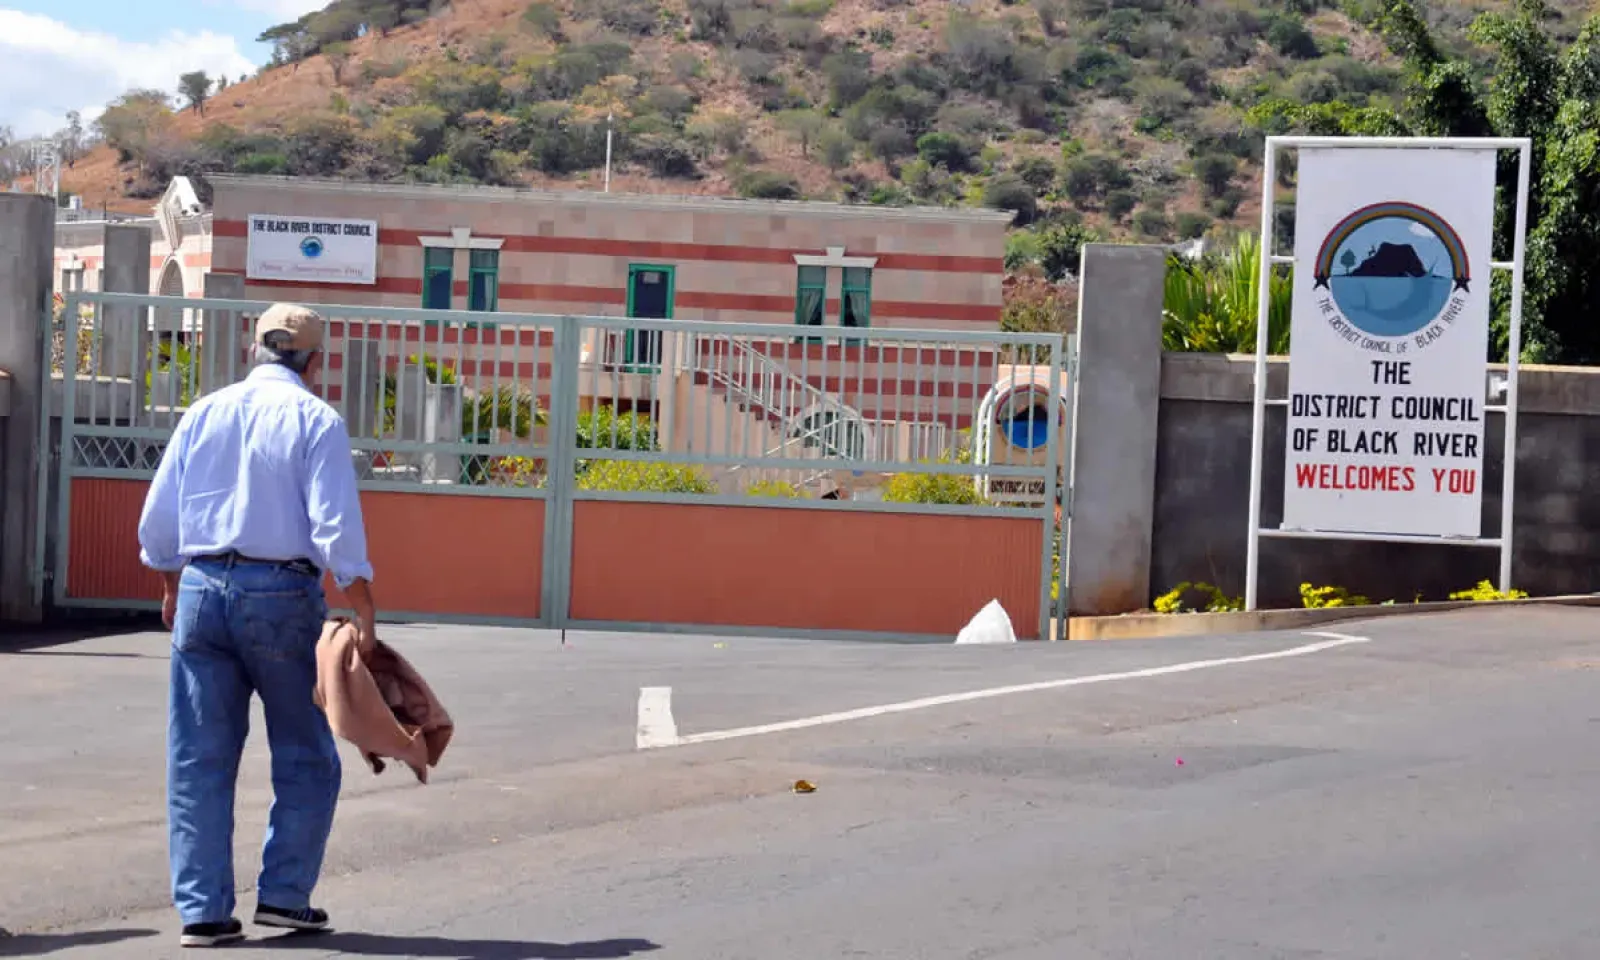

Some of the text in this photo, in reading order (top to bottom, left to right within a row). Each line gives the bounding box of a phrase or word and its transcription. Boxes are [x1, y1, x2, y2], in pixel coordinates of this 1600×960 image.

[254, 219, 371, 236] THE BLACK RIVER DISTRICT COUNCIL
[1319, 297, 1464, 353] THE DISTRICT COUNCIL OF BLACK RIVER
[1371, 360, 1411, 384] THE
[1292, 394, 1479, 421] DISTRICT COUNCIL
[1293, 428, 1478, 458] OF BLACK RIVER
[1296, 463, 1476, 494] WELCOMES YOU
